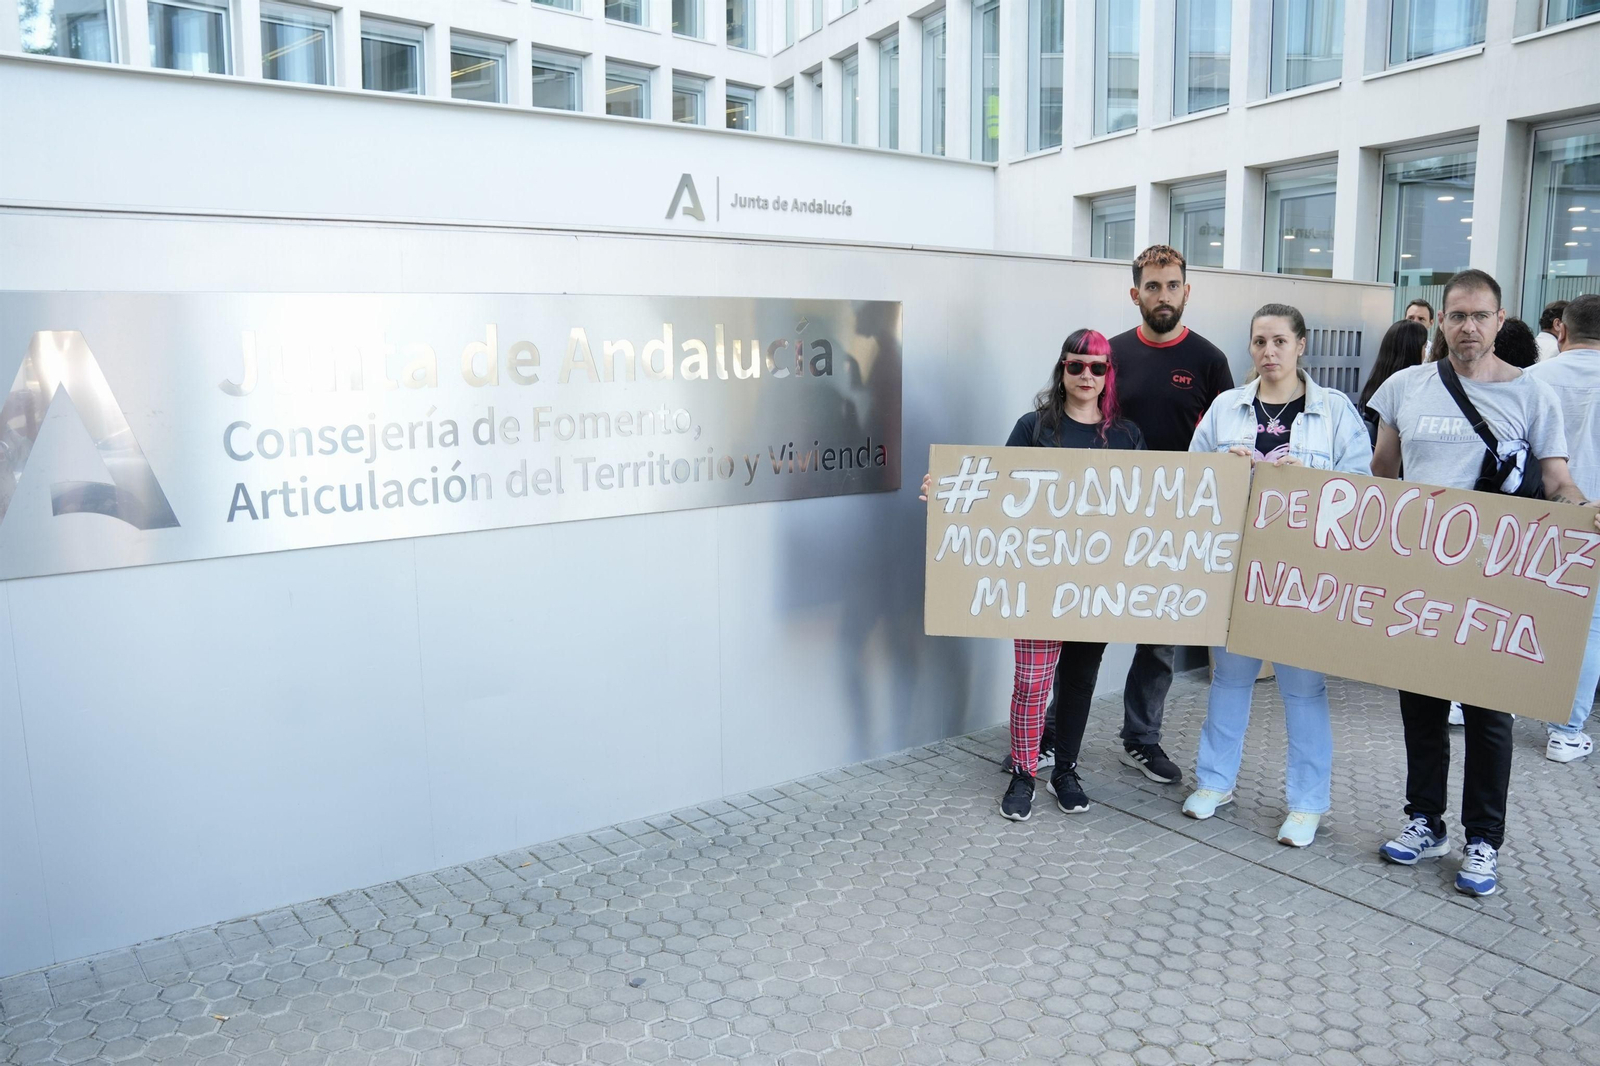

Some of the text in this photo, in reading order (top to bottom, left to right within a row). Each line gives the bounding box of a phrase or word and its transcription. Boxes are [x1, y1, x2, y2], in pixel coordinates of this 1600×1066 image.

[731, 193, 852, 216] Junta de Andalucía
[218, 317, 833, 397] Junta de Andalucía
[1172, 374, 1192, 385] CNT
[223, 402, 701, 463] Consejería de Fomento,
[227, 436, 888, 523] Articulación del Territorio y Vivienda
[934, 523, 1240, 574] MORENO DAME
[1254, 477, 1600, 598] DE ROCÍO DÍAZ
[970, 576, 1207, 621] MI DINERO
[1245, 560, 1545, 664] NADIE SE FIA
